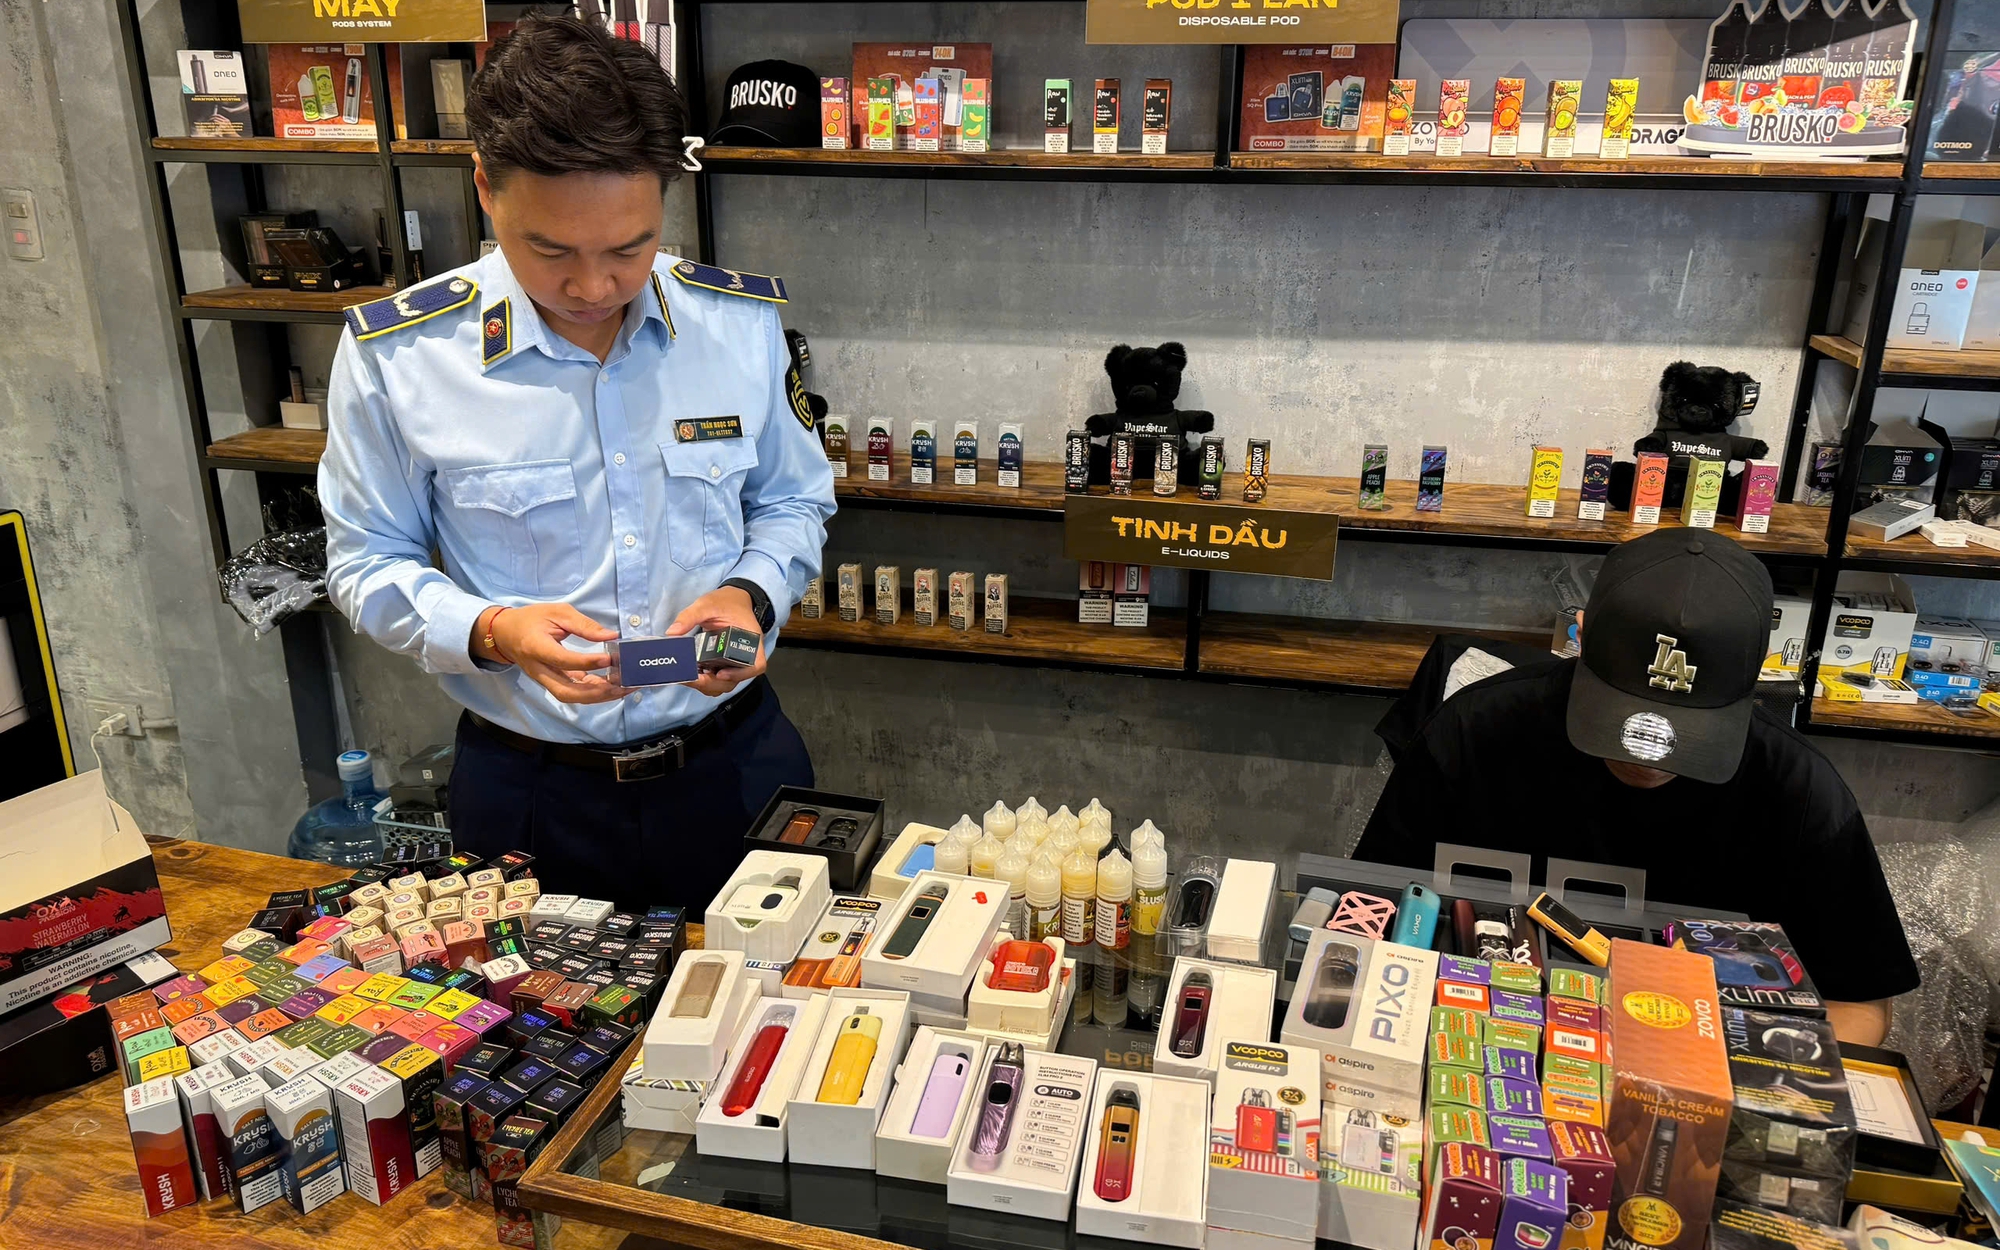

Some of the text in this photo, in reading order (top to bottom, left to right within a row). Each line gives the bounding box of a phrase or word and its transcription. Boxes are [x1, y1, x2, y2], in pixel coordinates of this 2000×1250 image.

[357, 20, 392, 28] SYSTEM
[1178, 15, 1300, 26] DISPOSABLE POD
[1784, 57, 1825, 75] BRUSKO
[730, 80, 797, 110] BRUSKO
[288, 127, 315, 135] COMBO
[1747, 113, 1838, 144] BRUSKO
[1072, 438, 1082, 466] BRUSKO
[1117, 439, 1127, 468] BRUSKO
[1161, 442, 1171, 471] BRUSKO
[1206, 445, 1216, 473] BRUSKO
[1252, 447, 1262, 476] BRUSKO
[1161, 547, 1230, 560] E-LIQUIDS
[1839, 616, 1871, 625] VOOPOO
[639, 656, 678, 667] VOOPOO
[839, 900, 879, 909] VOOPOO
[33, 913, 88, 942] STRAWBERRY
[34, 922, 90, 949] WATERMELON
[48, 952, 93, 975] WARNING:
[1396, 954, 1424, 964] aspire
[5, 947, 139, 1008] Nicotine is an addictive chemical.
[8, 987, 28, 999] This
[29, 973, 62, 991] product
[63, 958, 98, 976] contains
[99, 943, 134, 961] nicotine.
[1369, 963, 1410, 1044] PIXO
[1694, 998, 1715, 1040] ZOVOO
[1232, 1045, 1285, 1059] VOOPOO
[1233, 1060, 1281, 1073] ARGUS P2
[1338, 1057, 1375, 1071] aspire
[219, 1077, 253, 1092] KRUSH
[273, 1078, 306, 1096] KRUSH
[1051, 1087, 1074, 1096] AUTO
[1338, 1084, 1375, 1099] aspire
[1641, 1103, 1705, 1124] TOBACCO
[1678, 1099, 1725, 1117] CREAM
[293, 1119, 334, 1149] KRUSH
[387, 1157, 402, 1195] KRUSH
[157, 1173, 176, 1210] KRUSH
